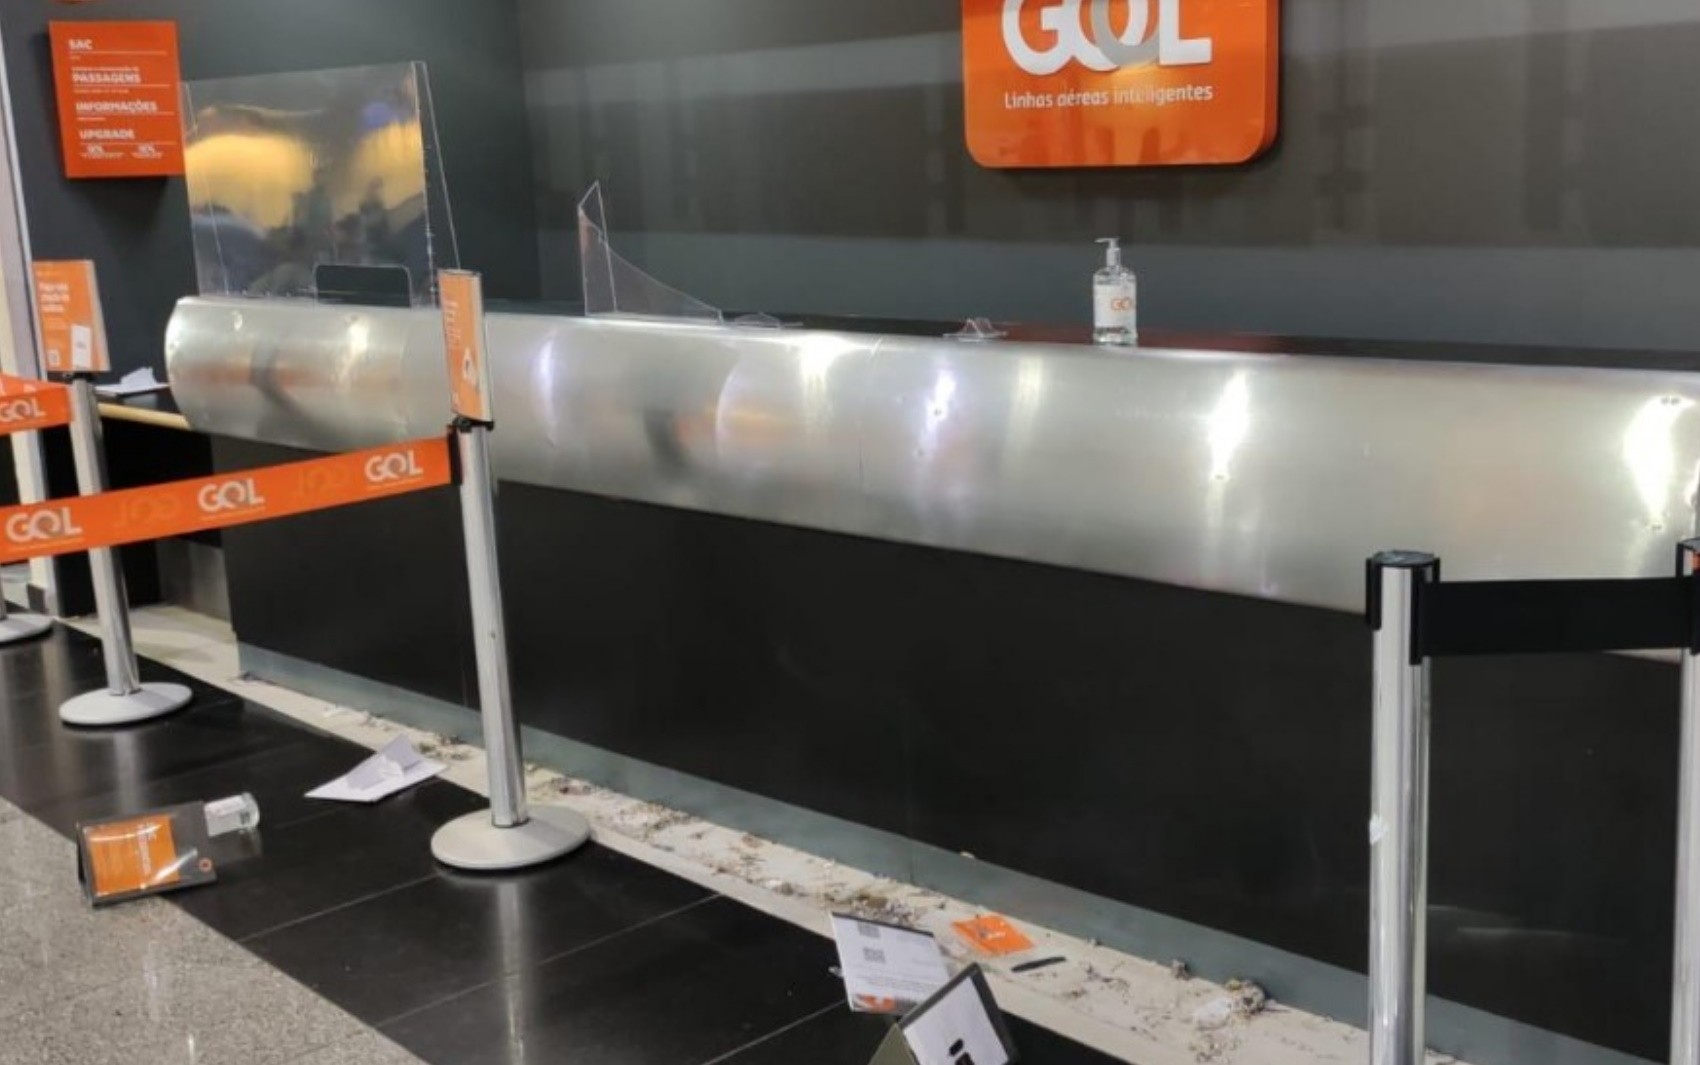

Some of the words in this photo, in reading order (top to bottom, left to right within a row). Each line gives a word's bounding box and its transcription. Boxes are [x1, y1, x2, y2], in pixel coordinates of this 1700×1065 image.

[68, 38, 93, 50] SAC
[1002, 0, 1212, 75] GOL
[72, 72, 141, 84] PASSAGENS
[76, 100, 158, 113] INFORMAÇÕES
[1005, 90, 1053, 109] Linhas
[1057, 88, 1109, 107] aéreas
[80, 128, 135, 140] UPGRADE
[0, 397, 46, 423] GOL
[364, 448, 424, 483] GOL
[197, 476, 266, 513] GOL
[6, 506, 83, 543] GOL
